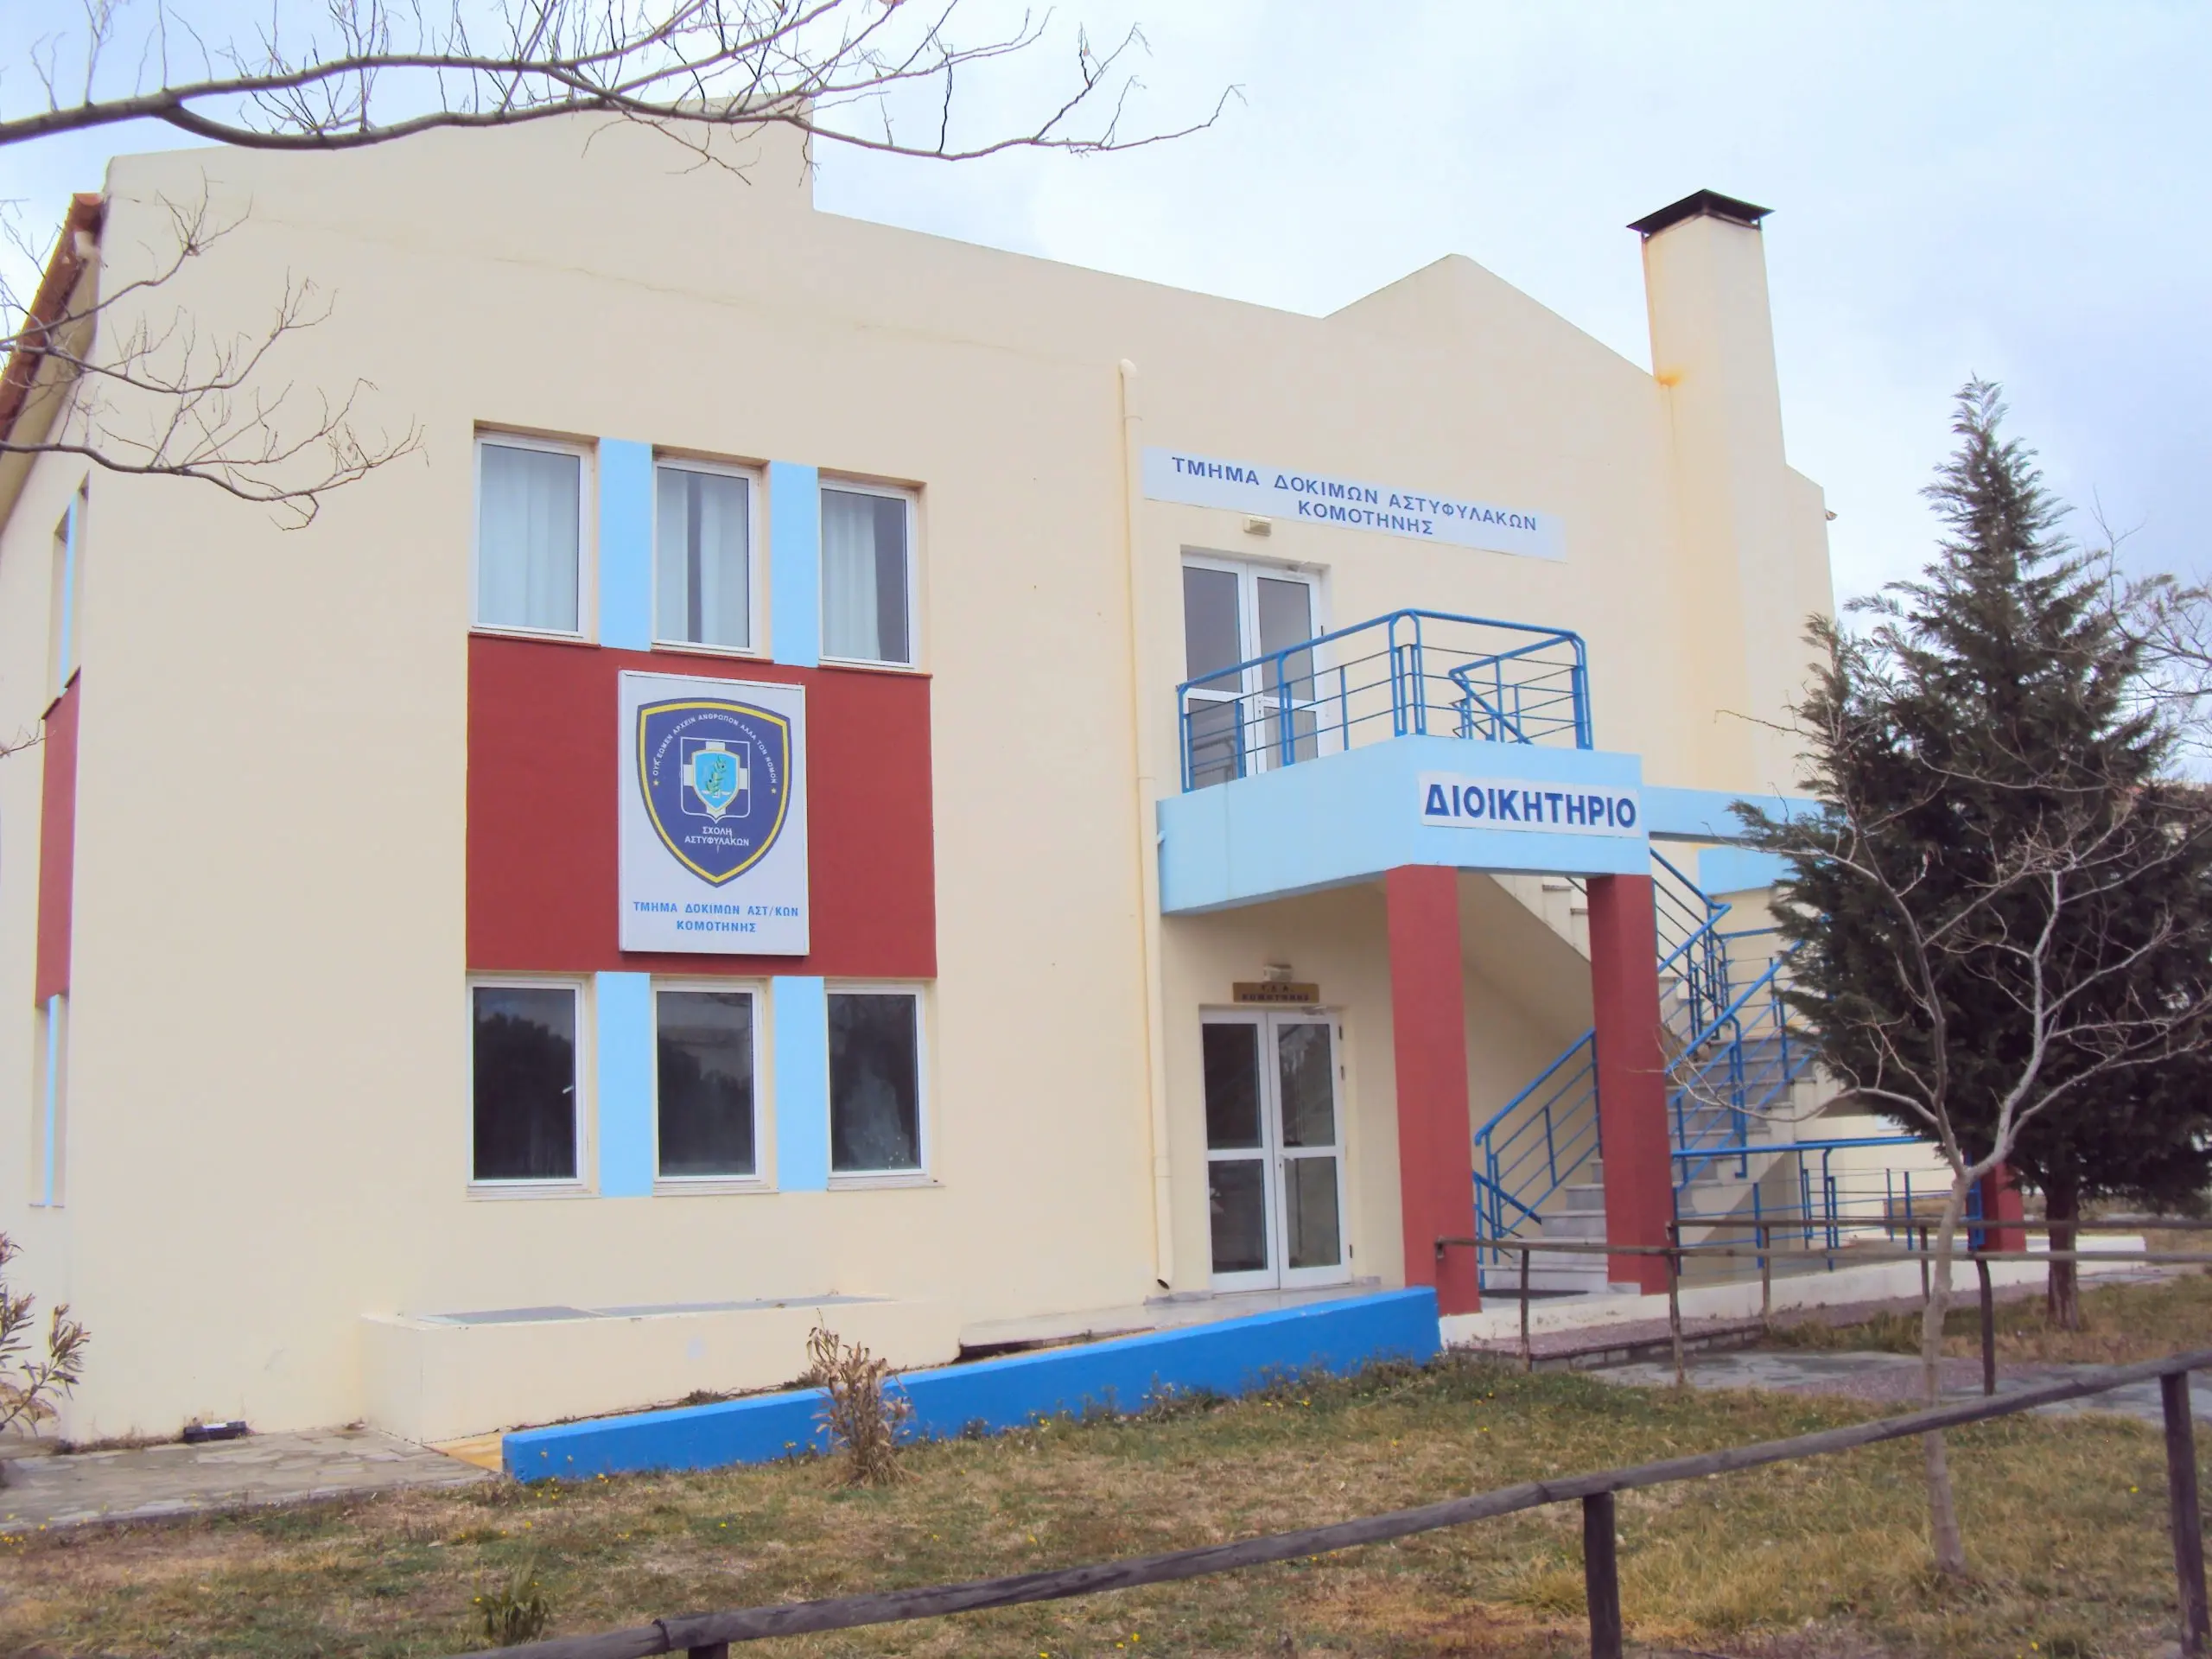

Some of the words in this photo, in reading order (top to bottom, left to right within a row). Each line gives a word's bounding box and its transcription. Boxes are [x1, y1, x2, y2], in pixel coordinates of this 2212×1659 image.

[1172, 456, 1260, 486] ΤΜΗΜΑ
[1274, 474, 1378, 505] ΔΟΚΙΜΩΝ
[1389, 493, 1538, 532] ΑΣΤΥΦΥΛΑΚΩΝ
[1298, 500, 1434, 536] ΚΟΜΟΤΗΝΗΣ
[756, 740, 768, 755] ΤΟΝ
[1425, 784, 1637, 829] ΔΙΟΙΚΗΤΗΡΙΟ
[702, 826, 733, 836] ΣΧΟΛΗ
[684, 836, 750, 847] ΑΣΤΥΦΥΛΑΚΩΝ
[633, 901, 677, 913] ΤΜΗΜΑ
[685, 903, 741, 916] ΔΟΚΙΜΩΝ
[747, 906, 799, 918] ΑΣΤ/ΚΩΝ
[677, 920, 757, 933] ΚΟΜΟΤΗΝΗΣ
